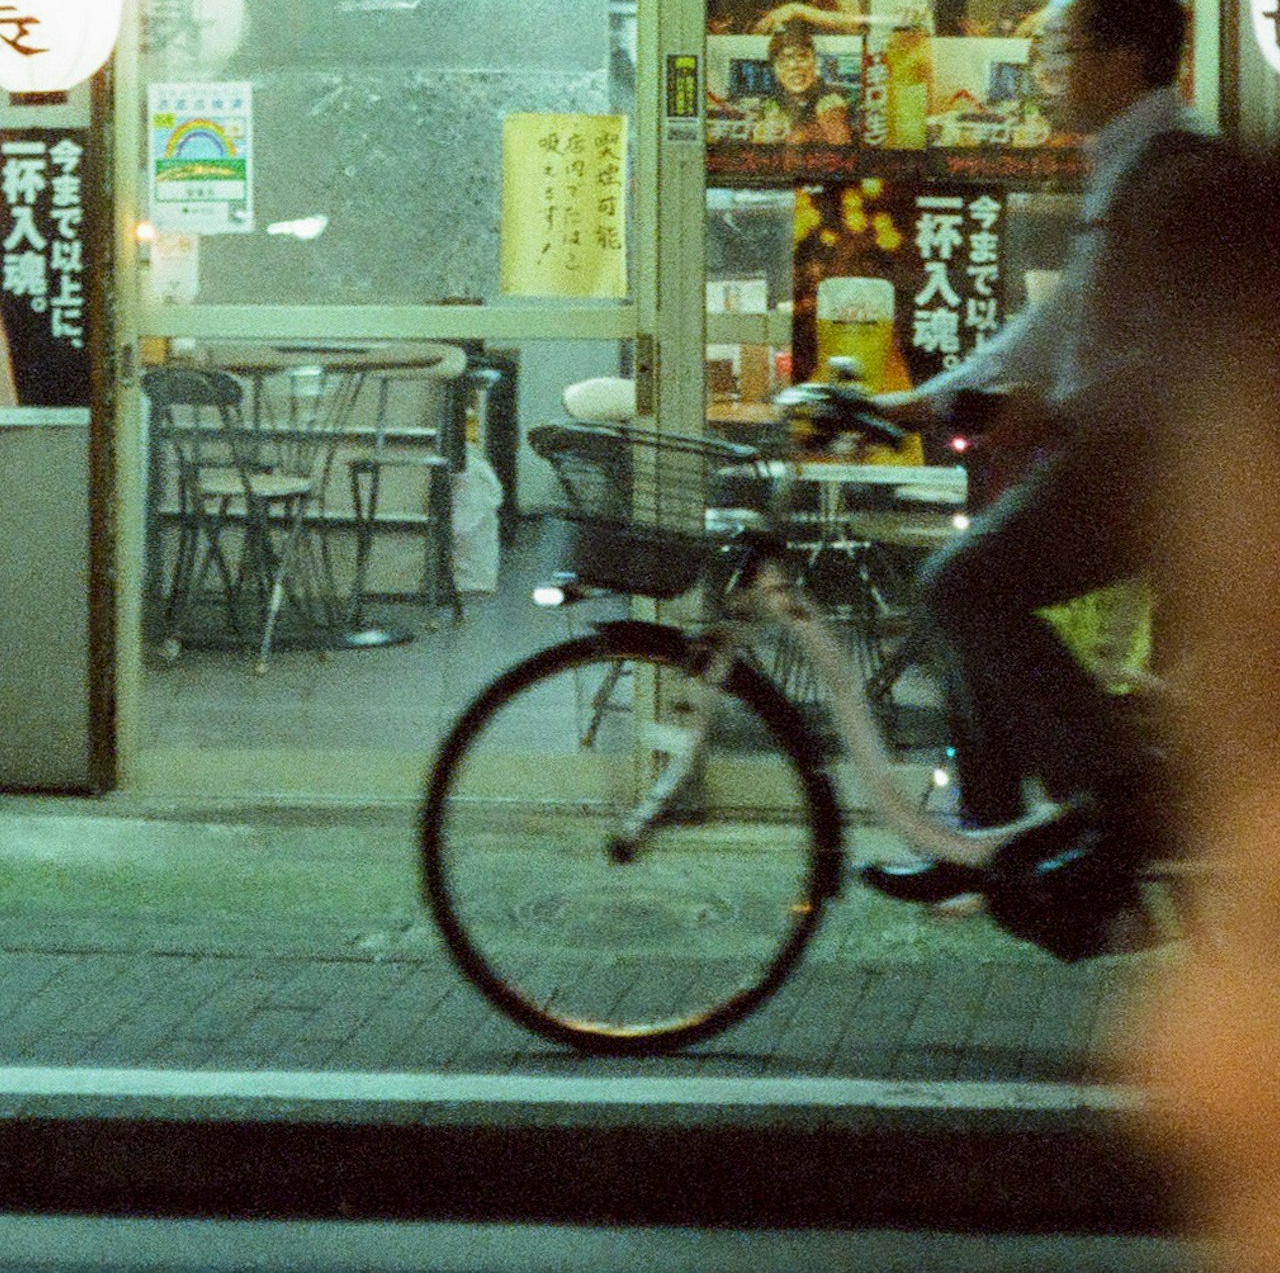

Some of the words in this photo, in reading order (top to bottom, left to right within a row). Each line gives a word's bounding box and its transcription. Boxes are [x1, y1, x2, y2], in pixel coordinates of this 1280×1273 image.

[0, 141, 49, 313] 一杯入魂。
[48, 139, 84, 349] 今まで以上に、
[912, 195, 965, 370] 一杯入魂。
